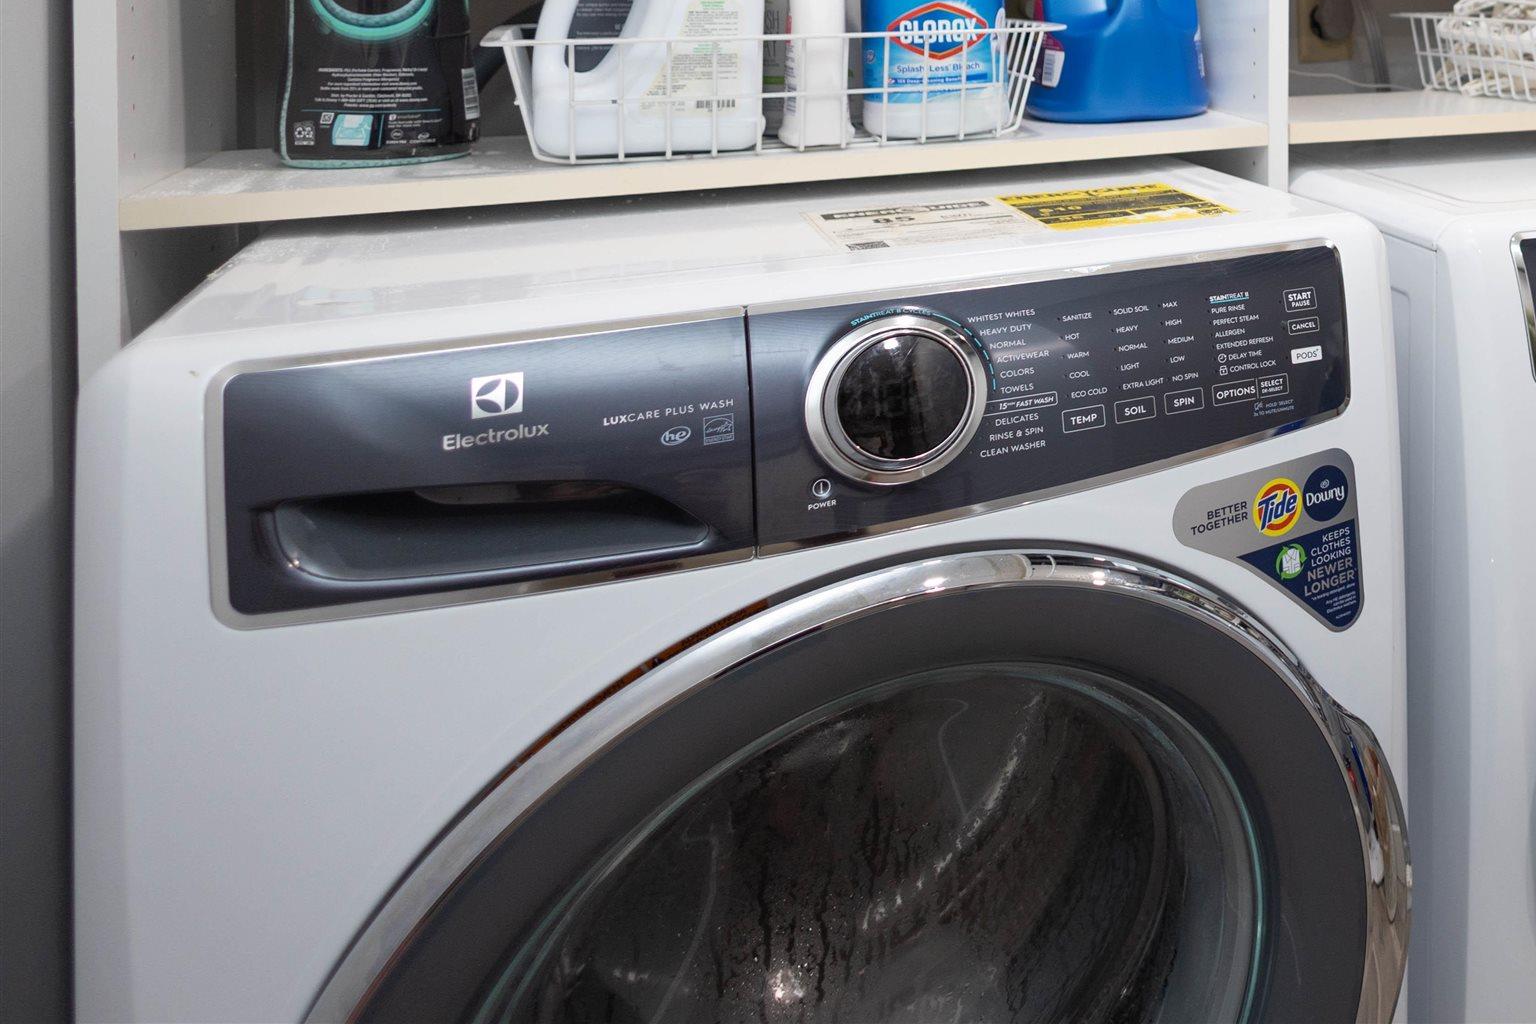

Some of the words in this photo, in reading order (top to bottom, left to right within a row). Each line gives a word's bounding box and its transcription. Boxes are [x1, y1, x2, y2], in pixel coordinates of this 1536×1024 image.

[900, 18, 978, 45] CLOROX
[896, 64, 924, 73] Splash
[952, 62, 980, 72] Blach
[1288, 291, 1312, 302] START
[1228, 304, 1245, 312] RINSE
[1292, 300, 1310, 308] PAUSE
[967, 312, 1003, 324] WHITEST
[1004, 308, 1036, 319] WHITES
[1114, 307, 1133, 316] SOLID
[1134, 305, 1150, 313] SOIL
[1062, 312, 1092, 322] SANITIZE
[1213, 317, 1238, 326] PERFECT
[1239, 314, 1260, 322] STEAM
[1165, 319, 1182, 327] HIGH
[1292, 321, 1316, 330] CANCEL
[980, 326, 1008, 337] HEAVY
[1010, 324, 1032, 333] DUTY
[1116, 325, 1139, 334] HEAVY
[1215, 328, 1245, 338] ALLERGEN
[1065, 333, 1080, 341] HOT
[1168, 336, 1195, 345] MEDIUM
[989, 339, 1027, 350] NORMAL
[1119, 343, 1148, 352] NORMAL
[1216, 340, 1248, 350] EXTENDED
[1249, 336, 1274, 345] REFRESH
[997, 350, 1050, 364] ACTIVEWEAR
[1170, 356, 1185, 364] LOW
[1228, 353, 1248, 361] DELAY
[1121, 362, 1140, 371] LIGHT
[1230, 364, 1259, 373] CONTROL
[1260, 360, 1277, 368] LOCK
[1001, 367, 1035, 379] COLORS
[1069, 371, 1090, 379] COOL
[1185, 372, 1199, 380] SPIN
[1001, 383, 1034, 394] TOWELS
[1123, 382, 1144, 391] EXTRA
[1145, 378, 1164, 387] LIGHT
[1261, 379, 1283, 388] SELECT
[1071, 391, 1087, 399] ECO
[1088, 387, 1108, 396] COLD
[1217, 386, 1256, 400] OPTIONS
[1016, 400, 1033, 408] FAST
[1034, 397, 1054, 405] WASH
[1174, 396, 1195, 407] SPIN
[603, 409, 660, 426] LUXCARE
[665, 405, 694, 416] PLUS
[700, 398, 734, 411] WASH
[1125, 405, 1146, 416] SOIL
[996, 413, 1039, 427] DELICATES
[1070, 413, 1098, 426] TEMP
[443, 424, 549, 451] Electrolux
[990, 431, 1014, 442] RINSE
[1025, 426, 1044, 437] SPIN
[980, 447, 1009, 458] CLEAN
[1011, 440, 1046, 452] WASHER
[1306, 484, 1345, 507] Downy
[808, 500, 837, 511] POWER
[1207, 501, 1248, 520] BETTER
[1258, 488, 1298, 534] Tide
[1191, 512, 1248, 536] TOGETHER
[1322, 527, 1350, 543] KEEPS
[1311, 537, 1351, 557] CLOTHES
[1312, 547, 1351, 567] LOOKING
[1307, 558, 1353, 582] NEWER
